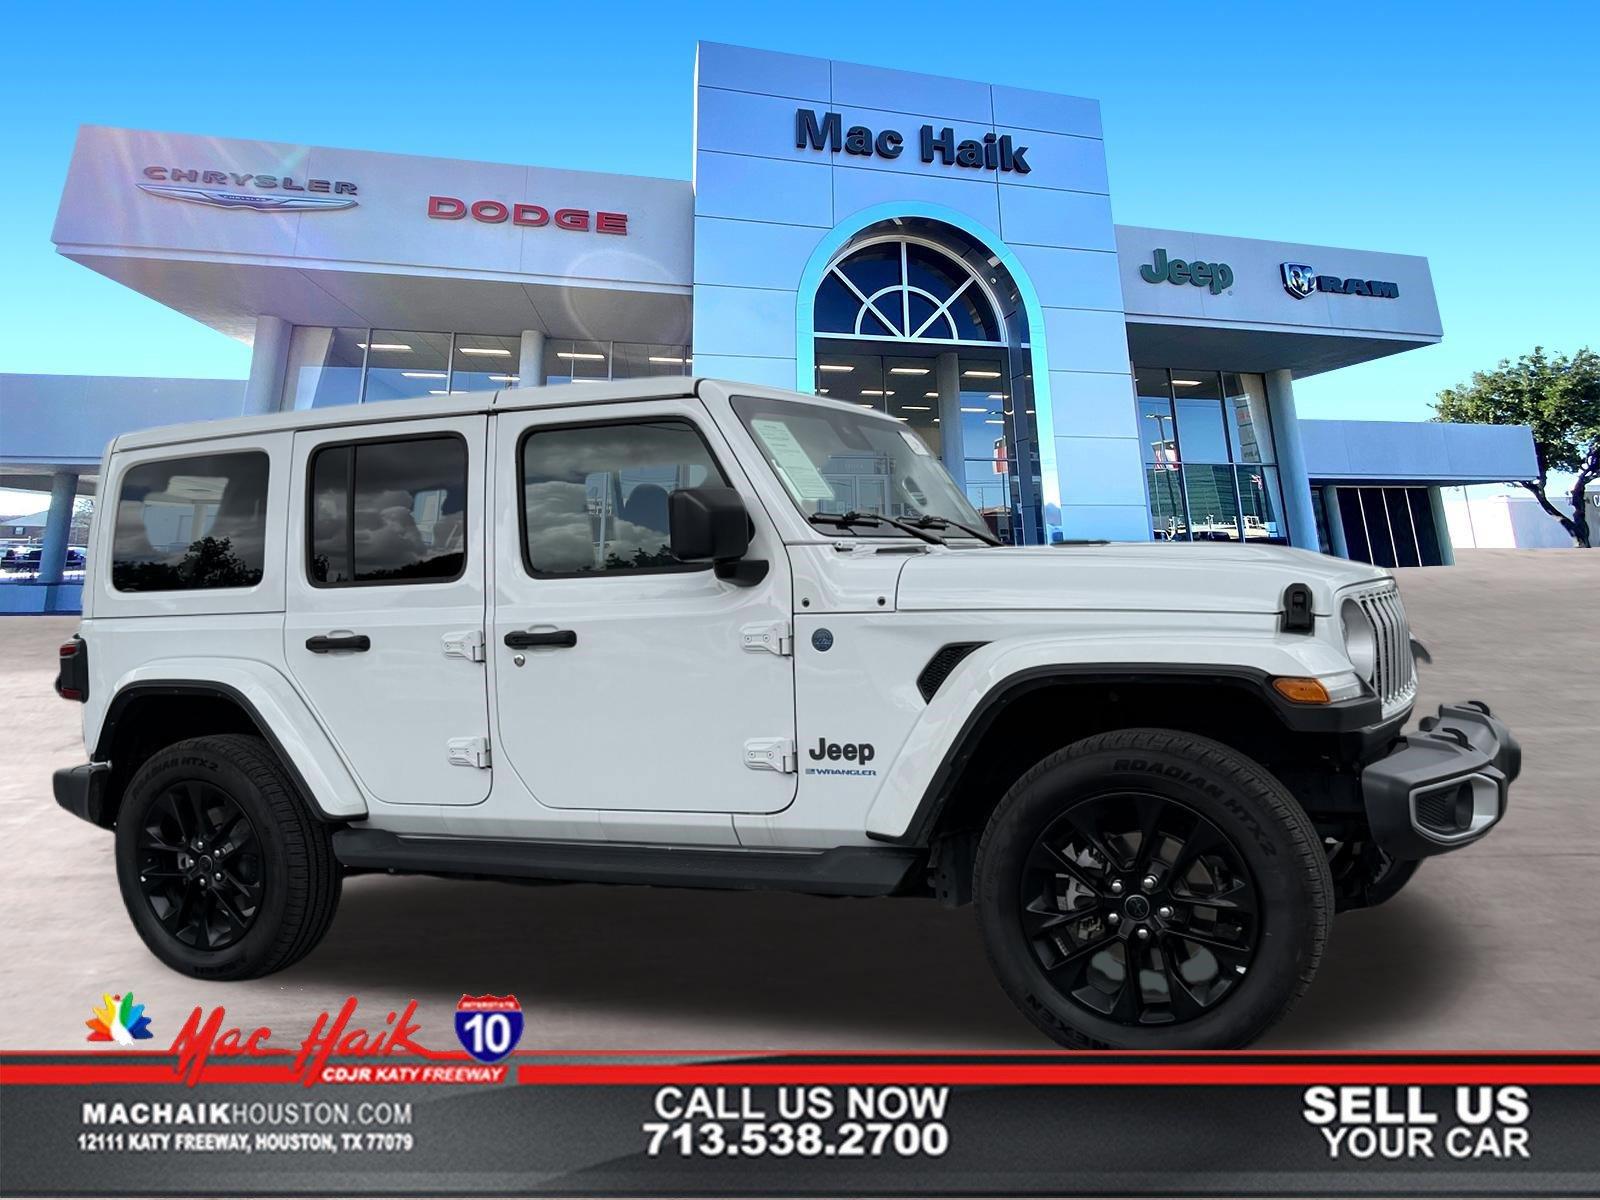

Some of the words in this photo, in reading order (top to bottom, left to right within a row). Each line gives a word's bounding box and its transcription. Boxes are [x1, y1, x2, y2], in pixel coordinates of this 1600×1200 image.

[795, 109, 904, 159] Mac
[920, 125, 1032, 174] Haik
[143, 166, 359, 196] CHRYSLER
[428, 196, 628, 236] DODGE
[1140, 248, 1234, 295] Jeep
[1316, 275, 1400, 299] RAM
[809, 737, 875, 765] Jeep
[816, 768, 877, 776] WRANGLER
[1113, 758, 1224, 799] ROADIAN
